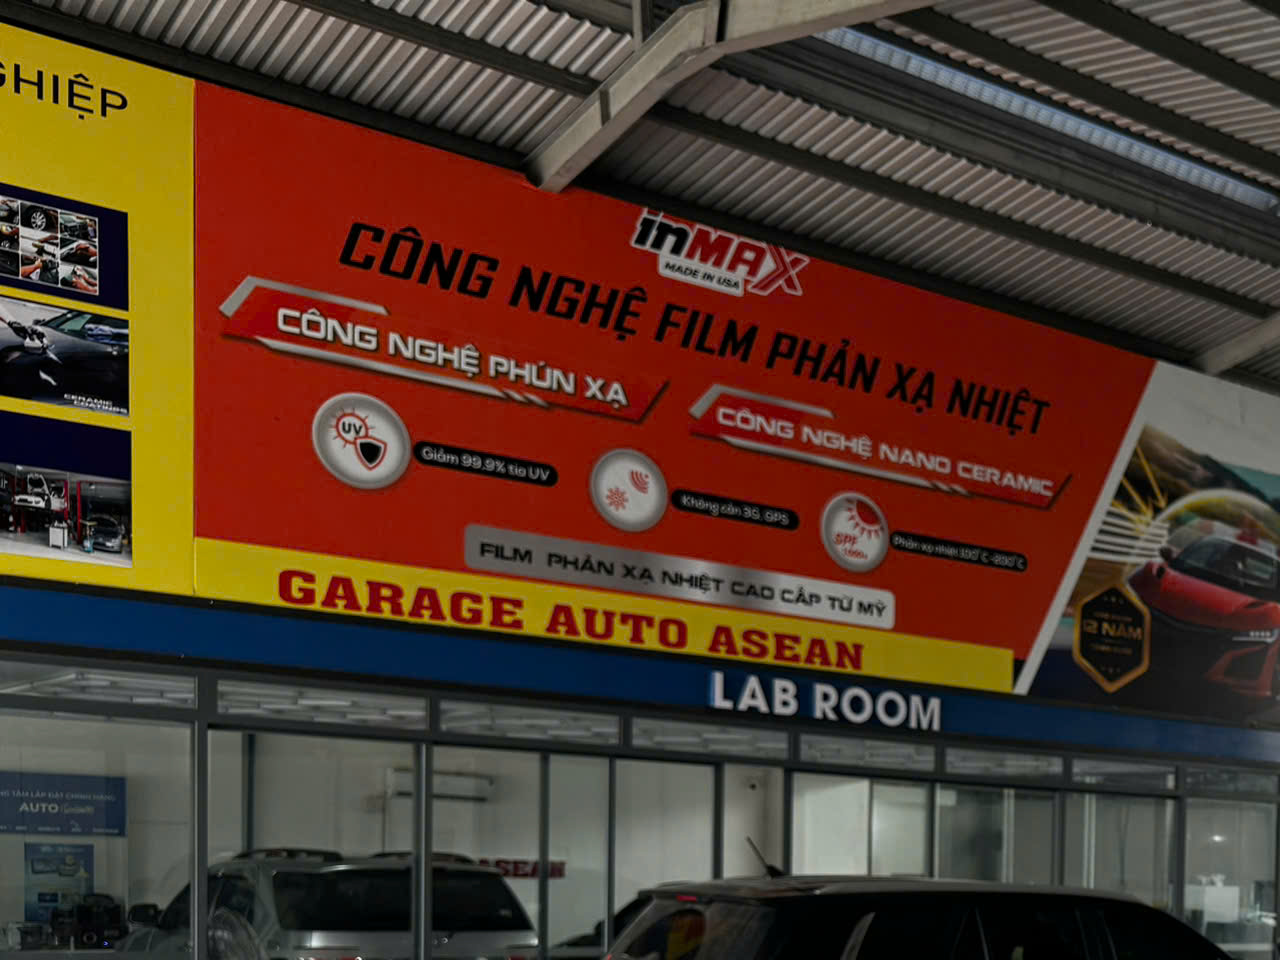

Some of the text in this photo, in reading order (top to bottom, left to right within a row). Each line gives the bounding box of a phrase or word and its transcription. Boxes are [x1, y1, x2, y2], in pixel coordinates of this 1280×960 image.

[0, 61, 128, 120] HIỆP
[664, 261, 740, 290] MADE IN USA
[276, 306, 630, 410] CÔNG NGHỆ PHÚN XẠ
[338, 221, 1052, 437] CÔNG NGHỆ FILM PHẢN XẠ NHIỆT
[341, 420, 363, 436] UV
[716, 406, 1055, 498] CÔNG NGHỆ NANO CERAMIC
[420, 445, 460, 465] Giảm
[527, 465, 551, 481] UV
[479, 541, 534, 566] FILM
[546, 551, 616, 578] PHẢN
[621, 564, 656, 585] XẠ
[661, 567, 726, 594] NHIỆT
[730, 580, 776, 602] CAO
[277, 569, 865, 672] GARAGE AUTO ASEAN
[709, 670, 943, 732] LAB ROOM
[19, 802, 60, 814] AUTO
